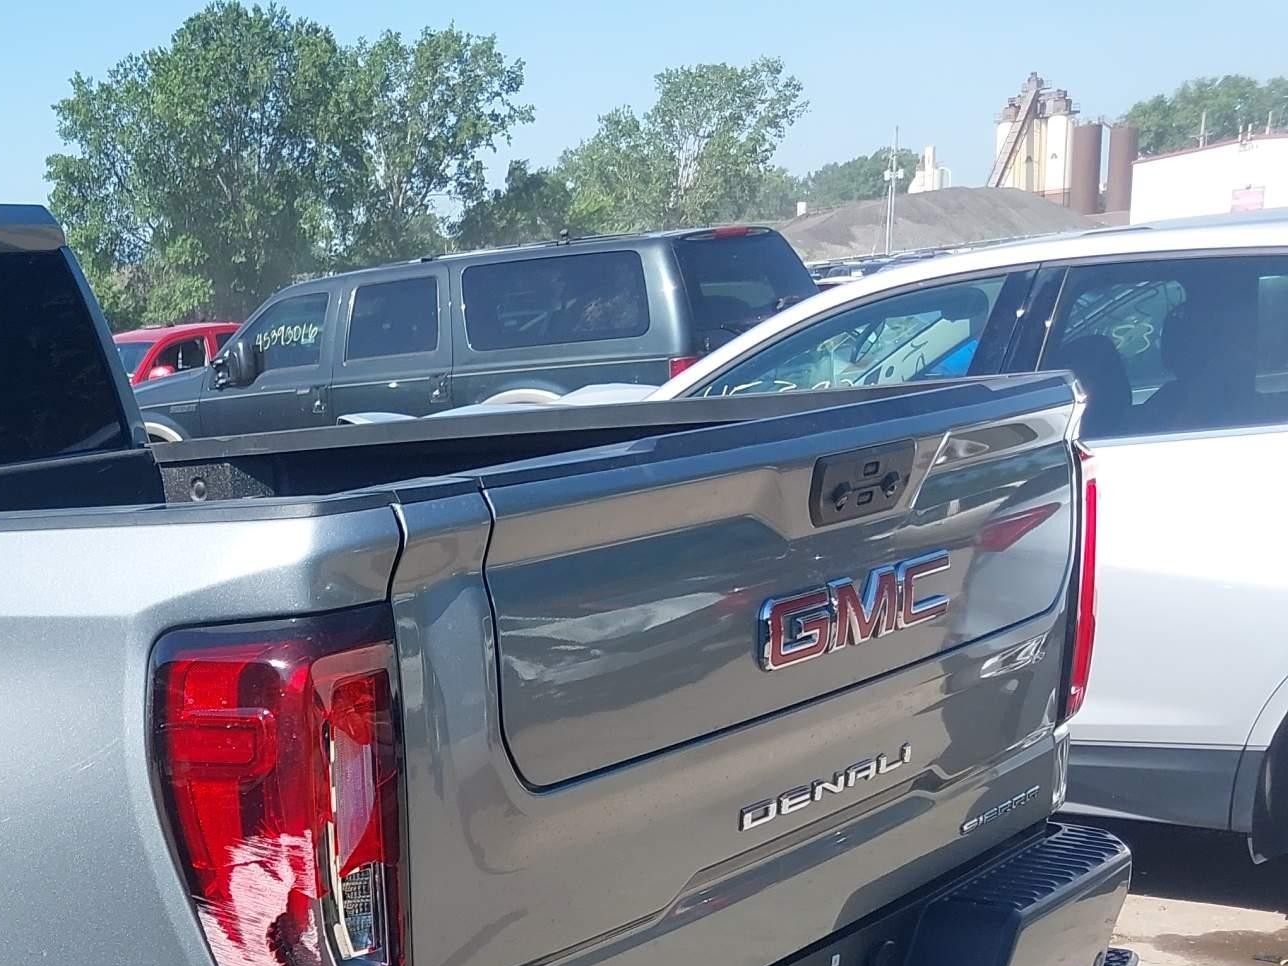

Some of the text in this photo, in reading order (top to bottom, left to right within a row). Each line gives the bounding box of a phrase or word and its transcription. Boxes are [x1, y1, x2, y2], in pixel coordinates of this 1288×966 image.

[757, 549, 950, 671] GMC
[739, 742, 911, 831] DENALI
[960, 785, 1040, 835] SIERRA
